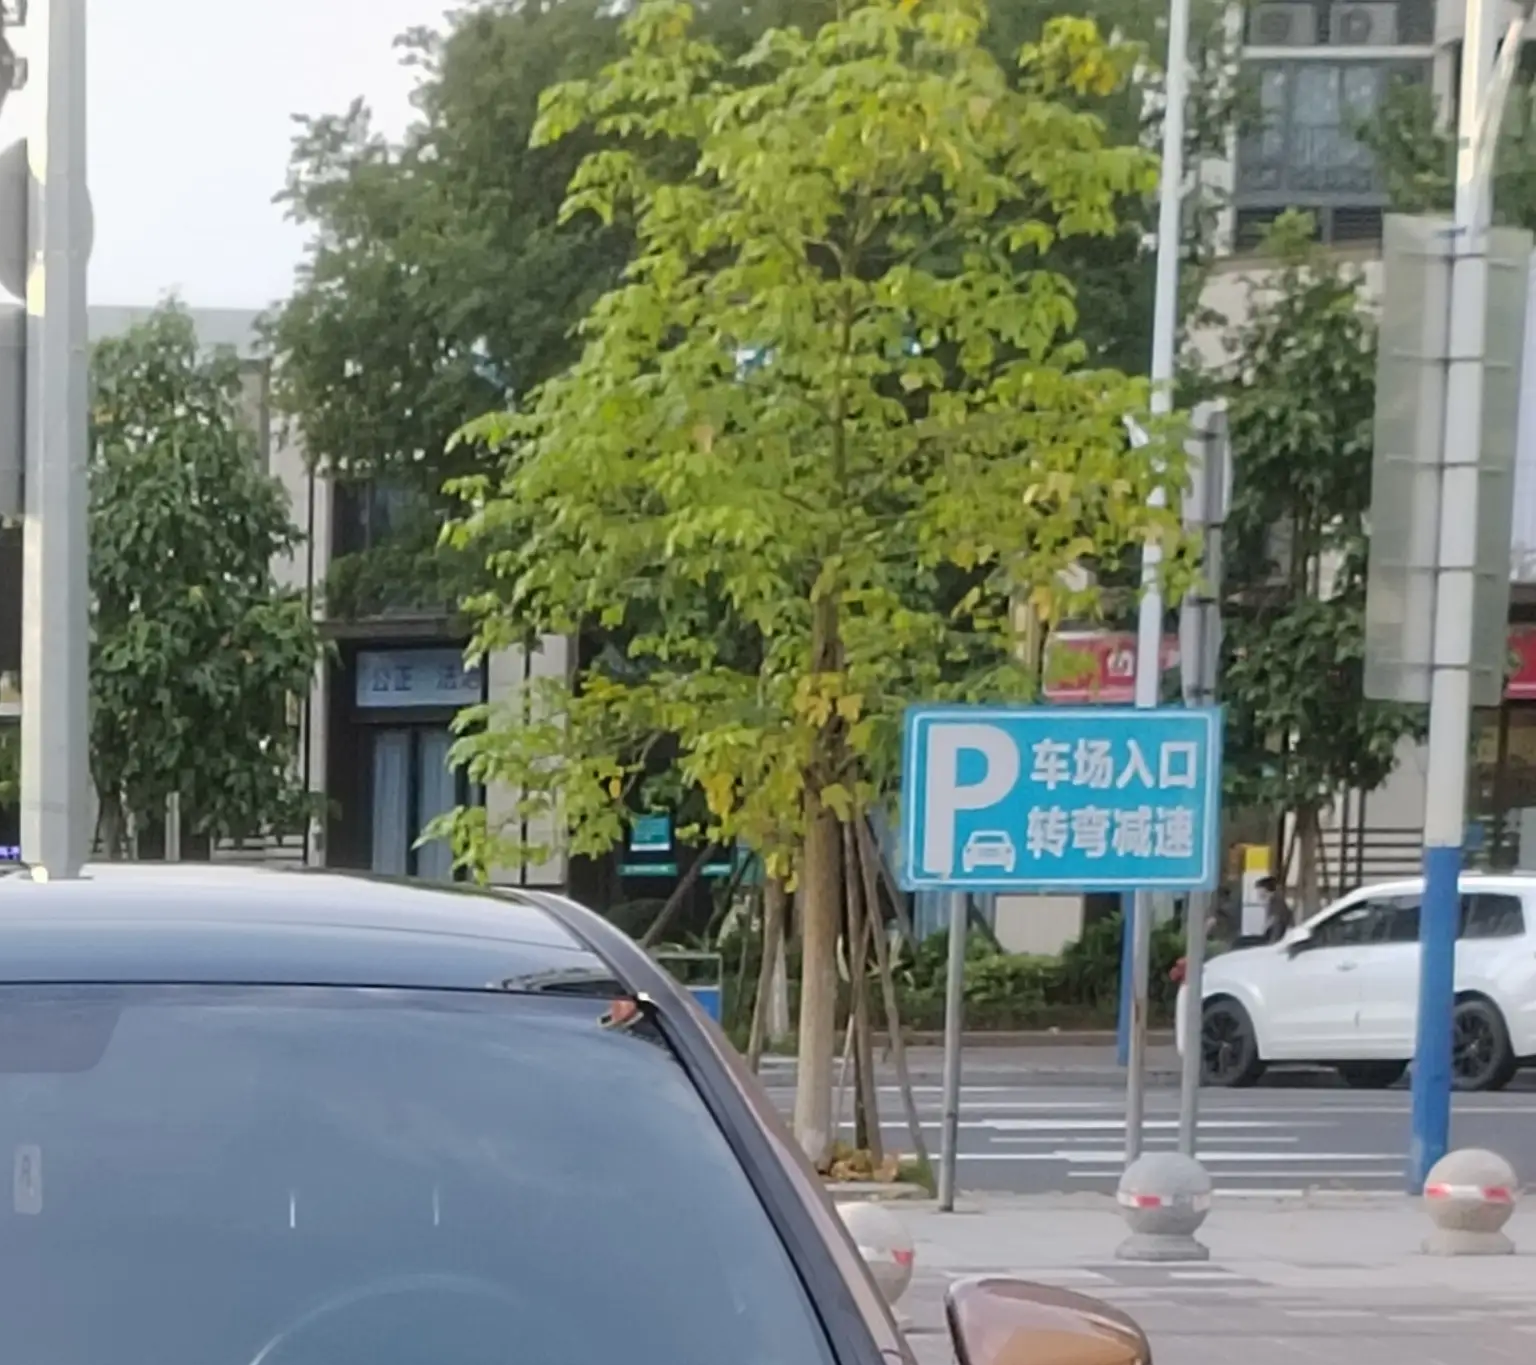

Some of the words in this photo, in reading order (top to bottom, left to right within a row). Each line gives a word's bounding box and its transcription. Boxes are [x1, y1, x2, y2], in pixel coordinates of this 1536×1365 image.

[1029, 738, 1198, 790] 车场入口
[923, 723, 1021, 874] P
[1026, 805, 1194, 859] 转弯减速
